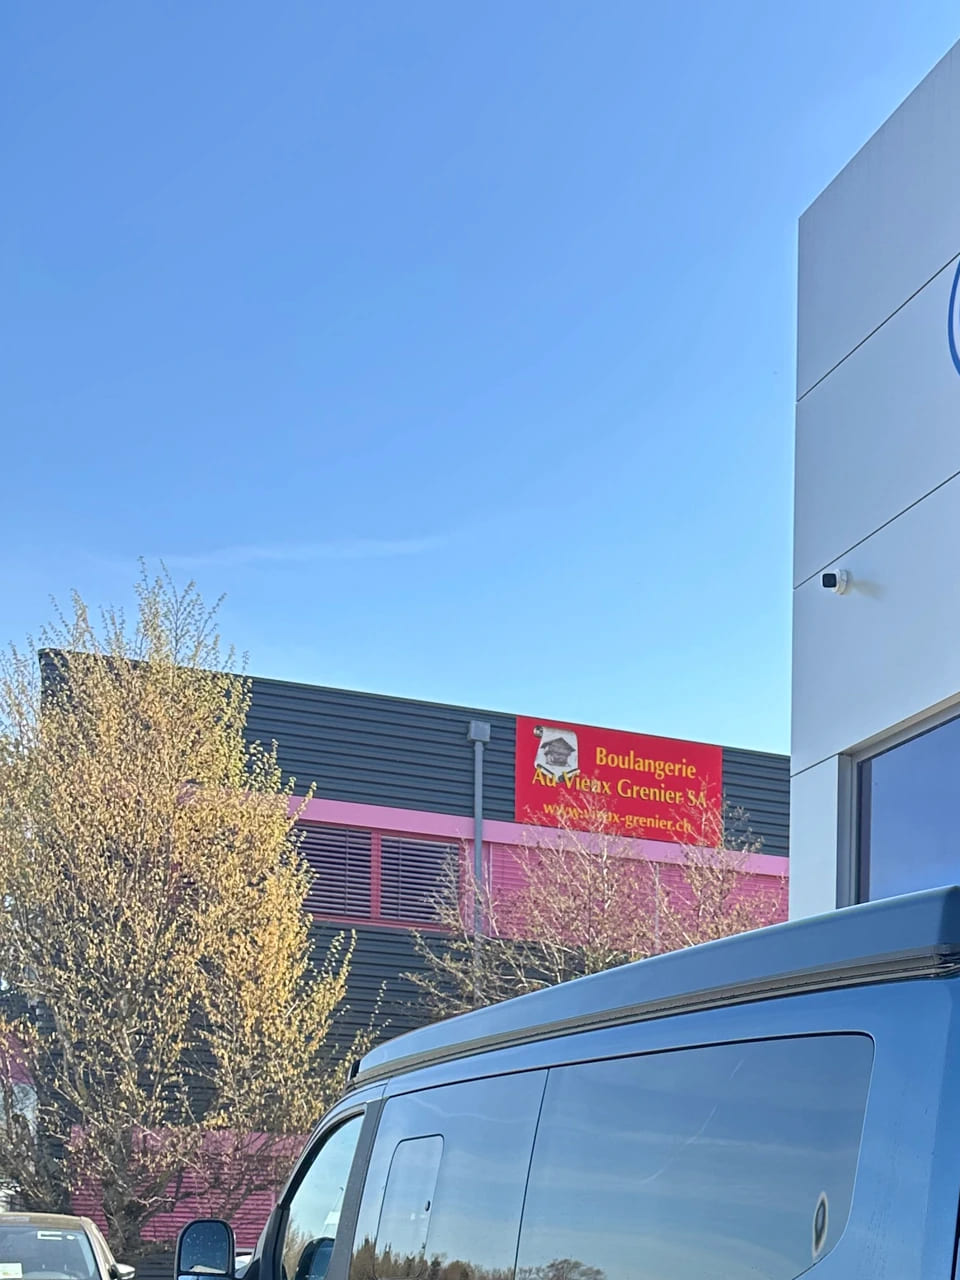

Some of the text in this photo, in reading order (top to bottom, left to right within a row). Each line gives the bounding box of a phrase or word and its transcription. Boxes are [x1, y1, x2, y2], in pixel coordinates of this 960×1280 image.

[595, 746, 697, 780] Boulangerie
[532, 767, 706, 808] Au Vieux Grenier SA
